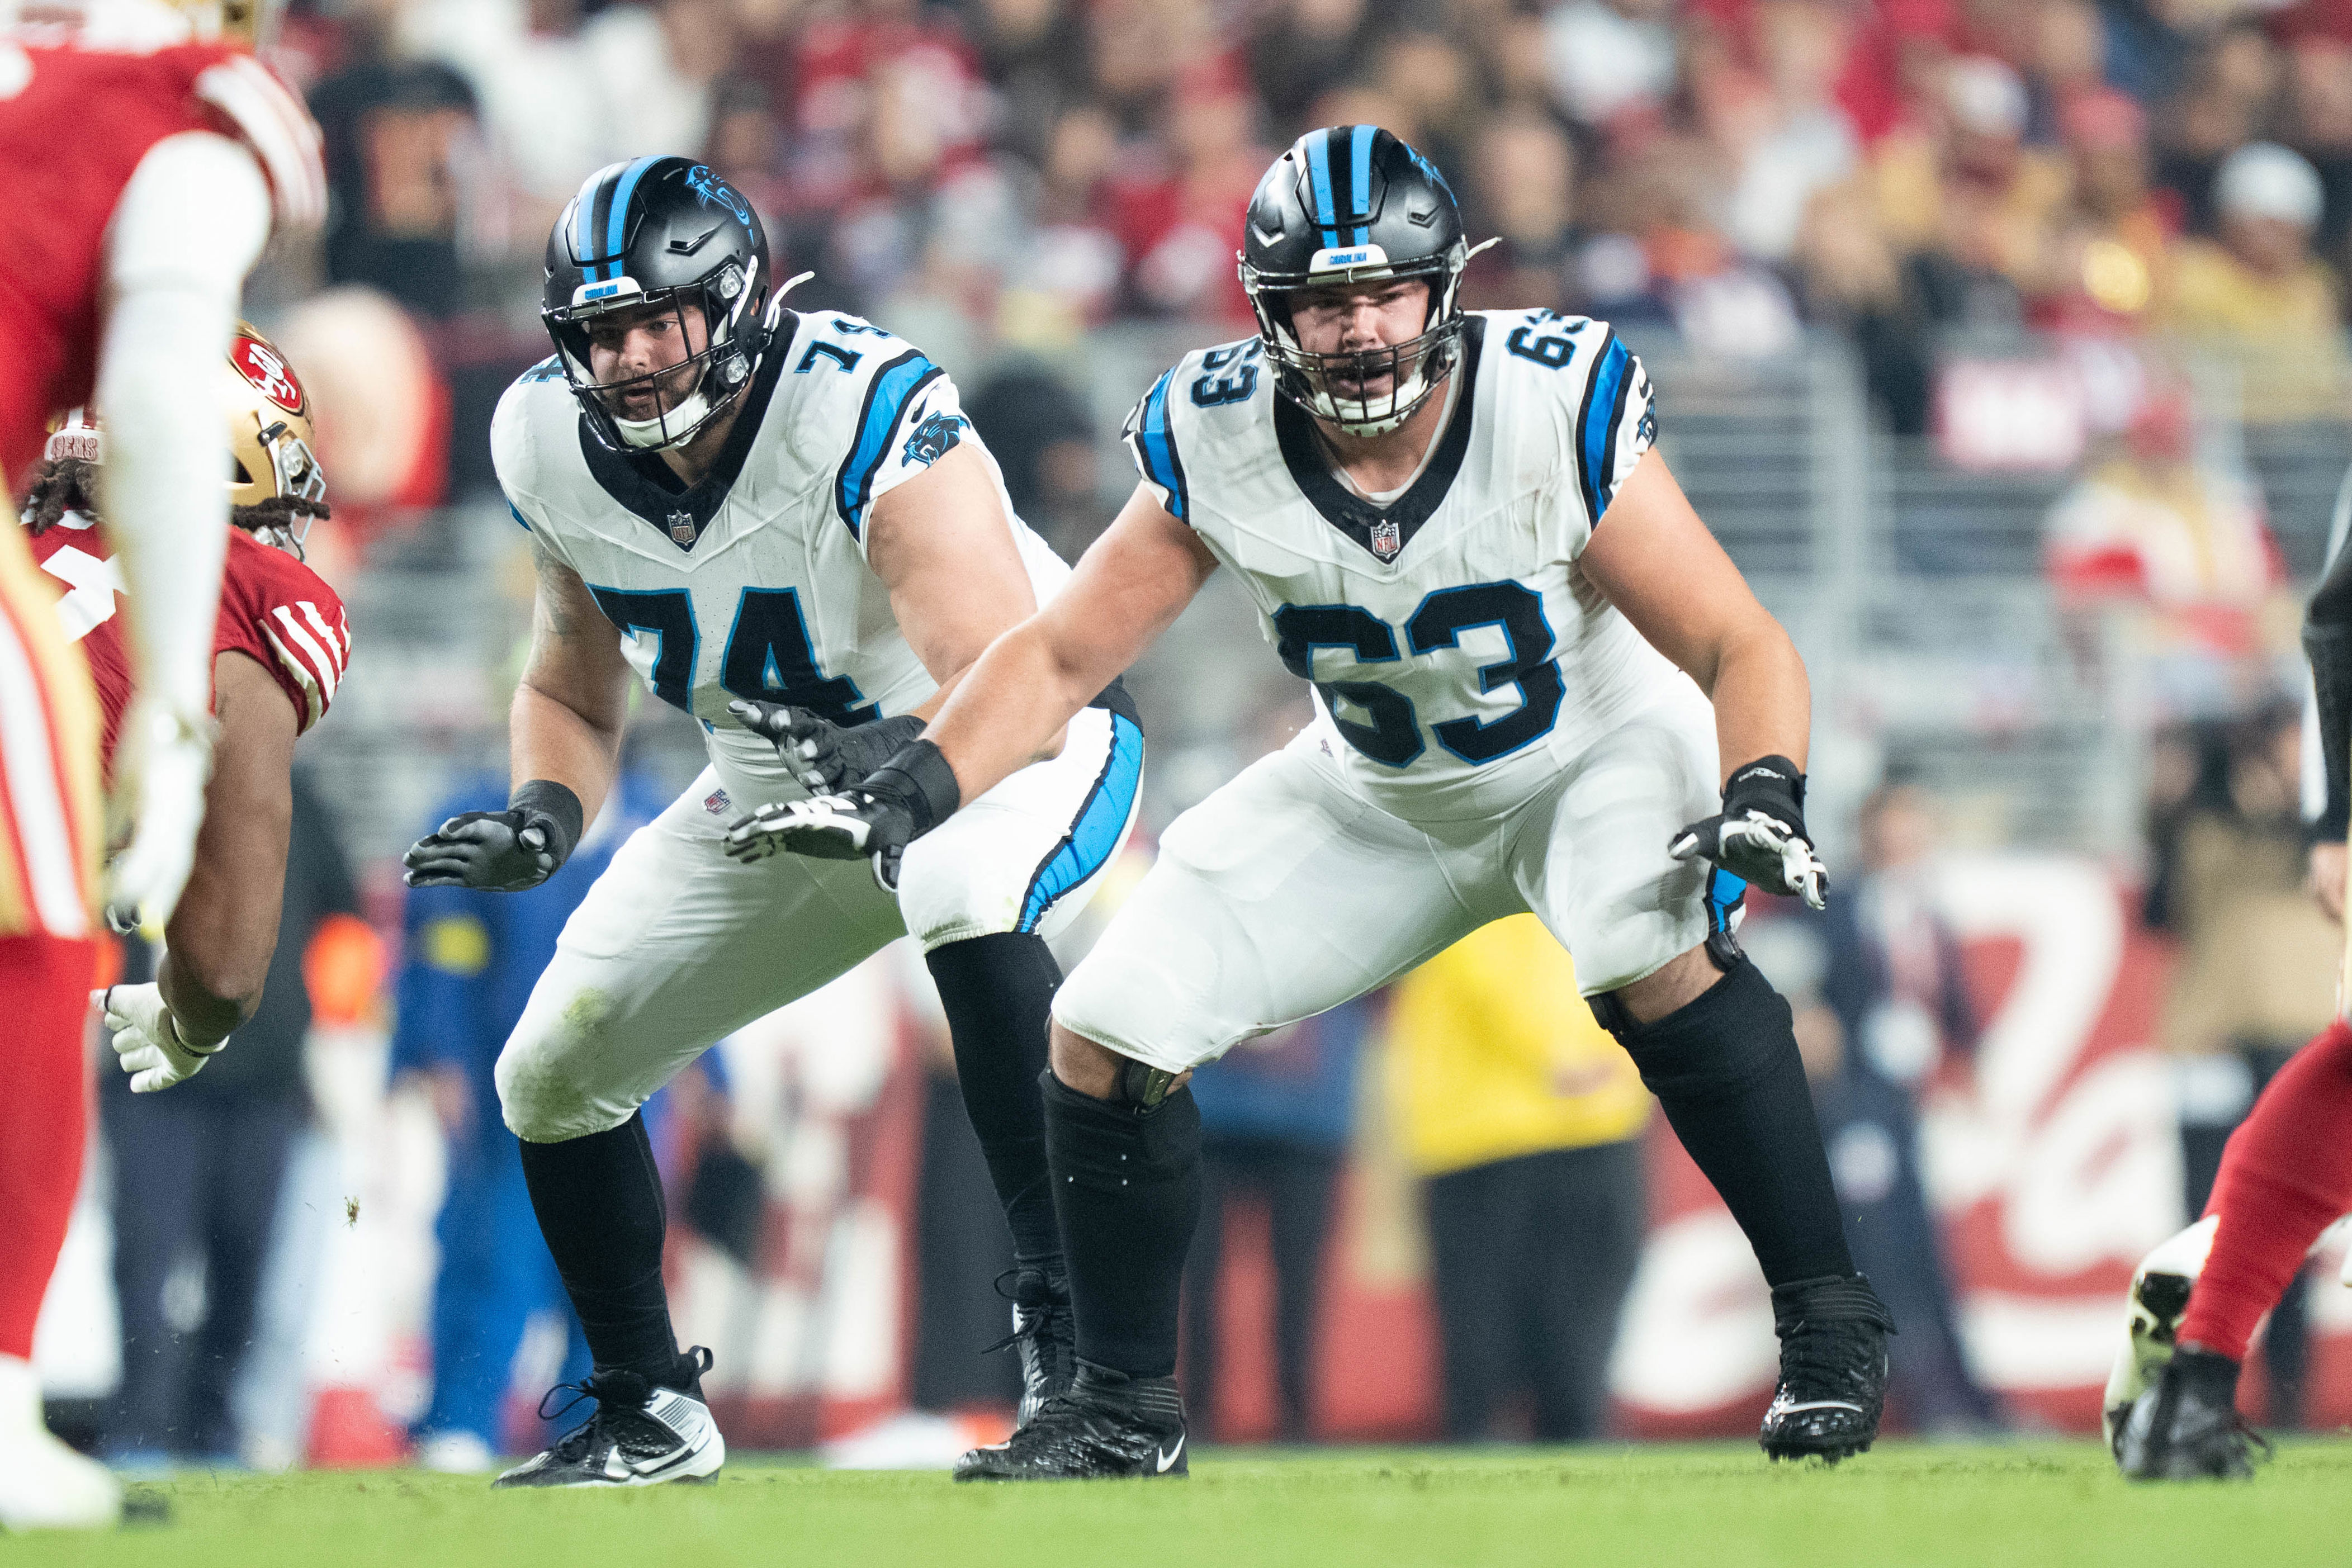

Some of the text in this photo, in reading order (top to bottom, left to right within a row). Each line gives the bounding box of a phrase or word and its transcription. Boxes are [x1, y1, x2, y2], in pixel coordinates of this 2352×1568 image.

[585, 284, 618, 300] CAROLINA
[673, 527, 693, 541] NFL
[1375, 537, 1397, 553] NFL
[585, 583, 883, 728] 74
[1271, 578, 1567, 768] 63
